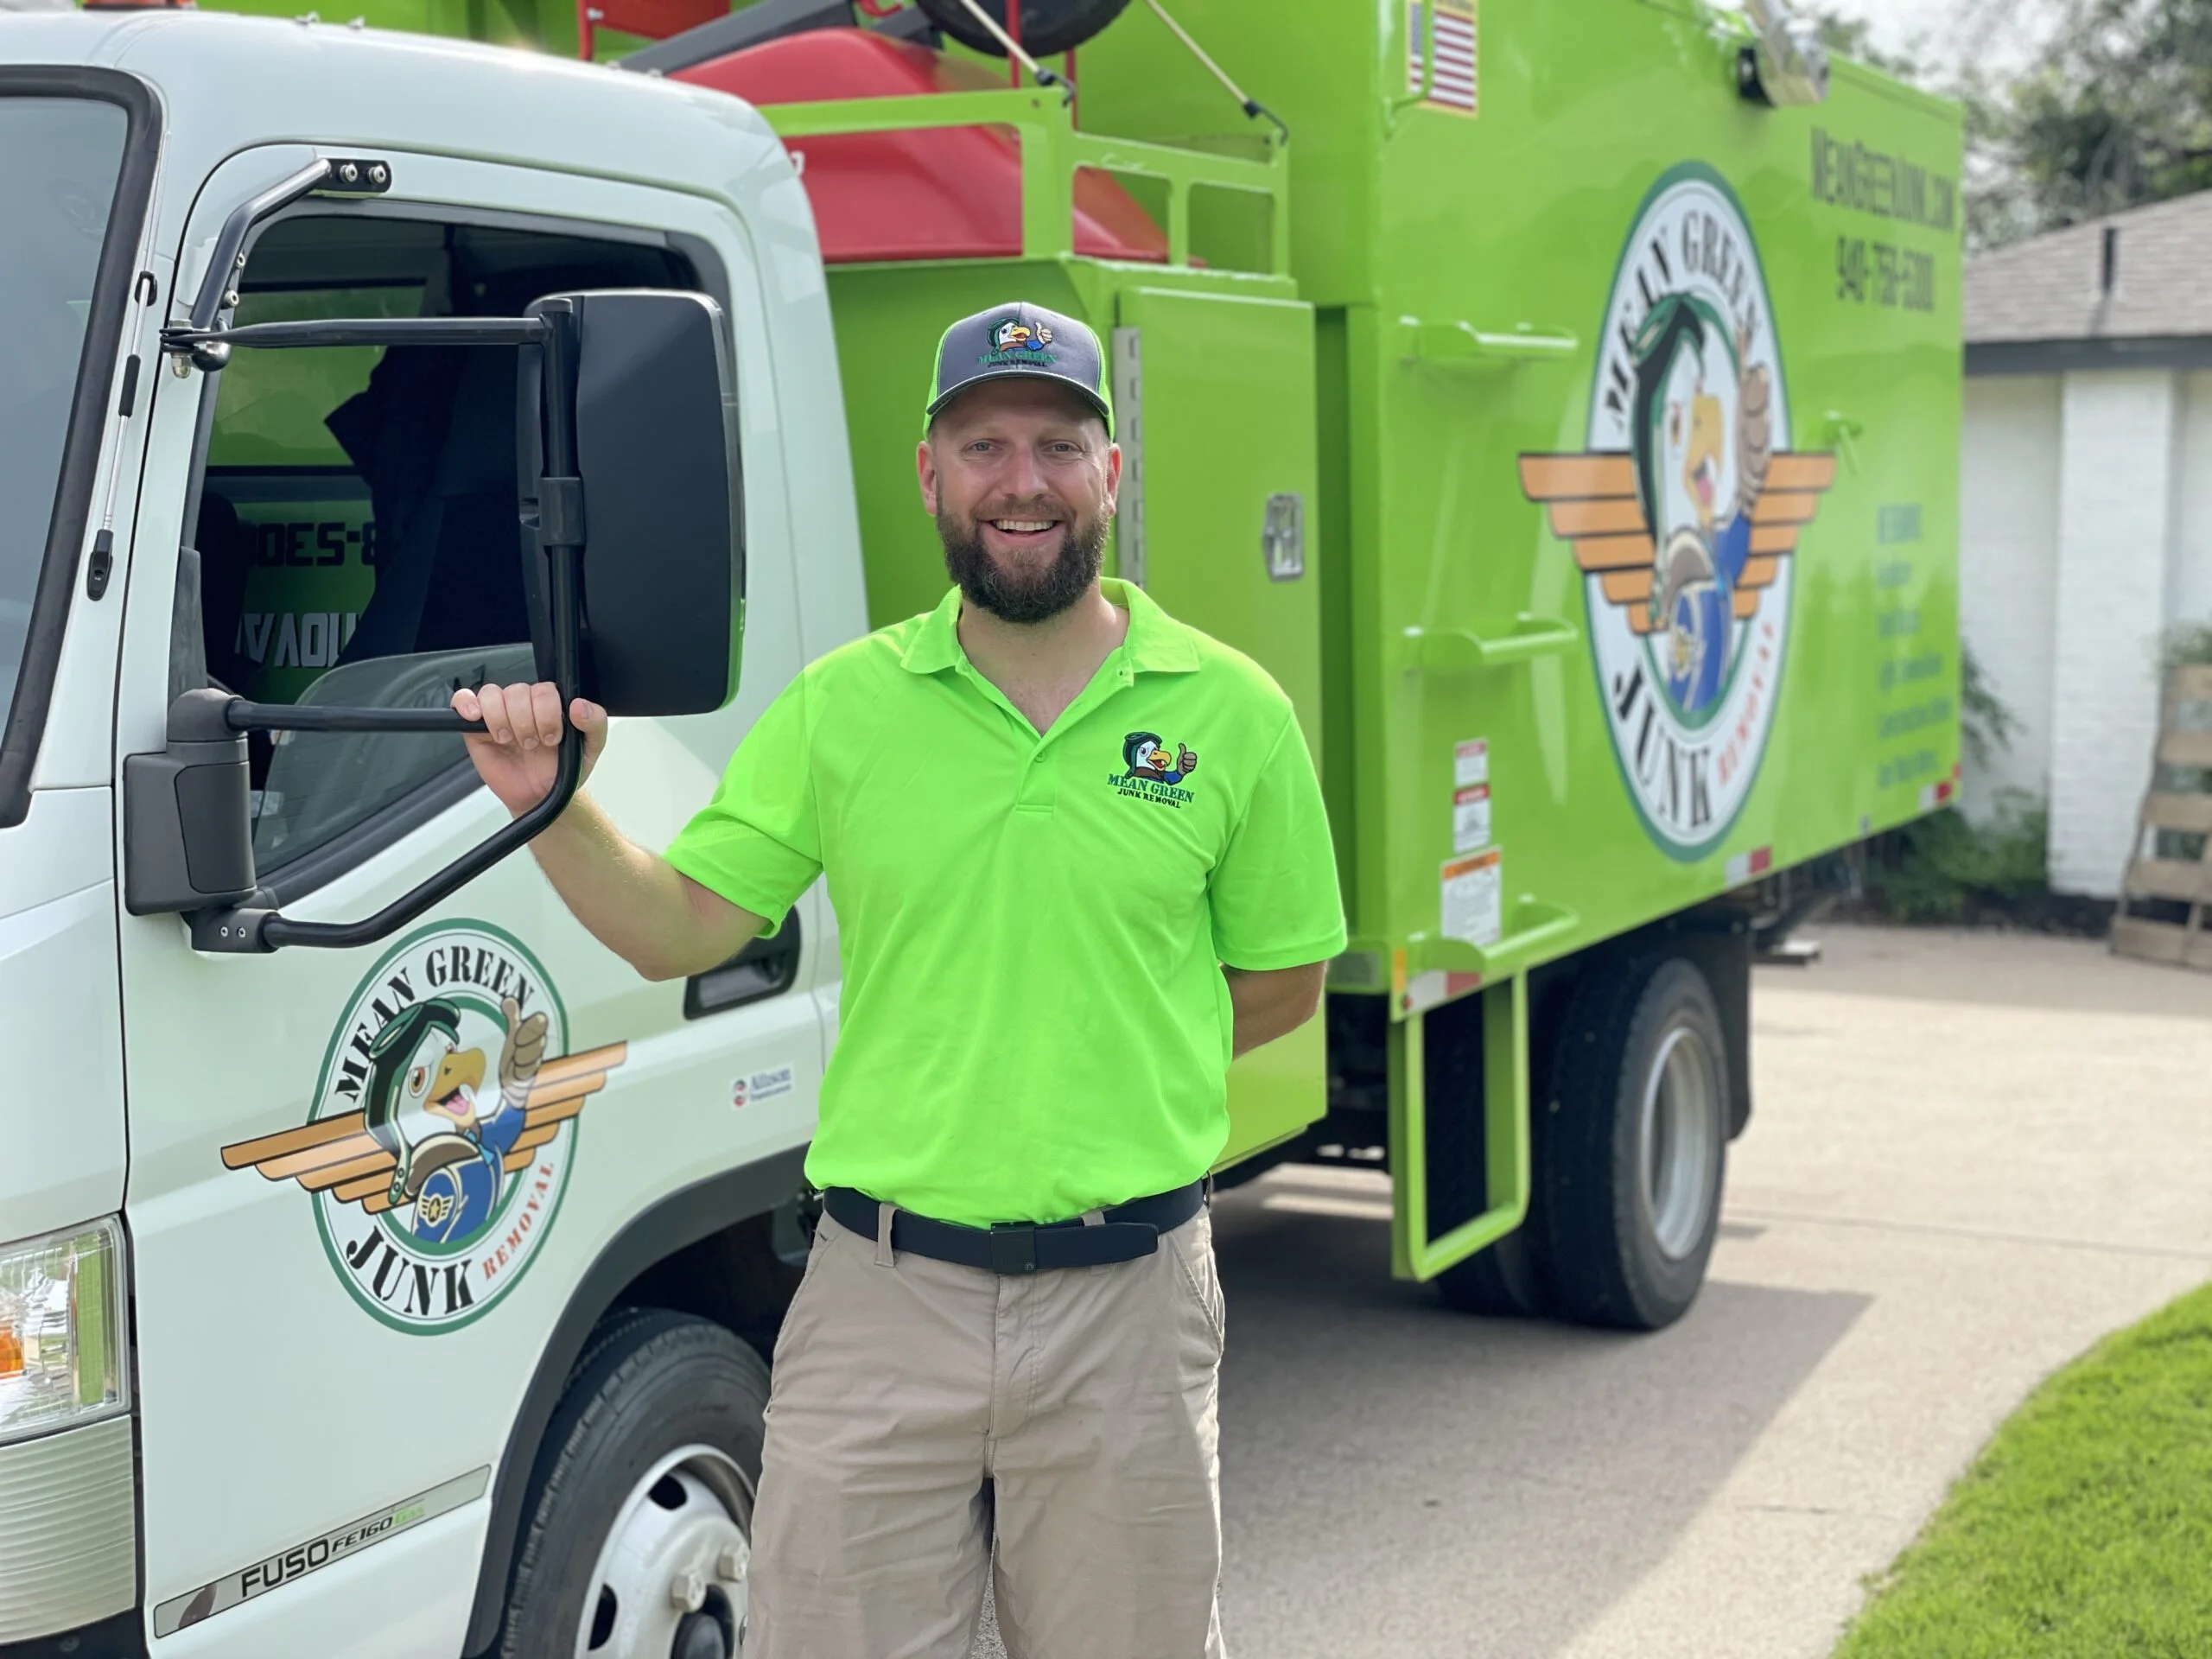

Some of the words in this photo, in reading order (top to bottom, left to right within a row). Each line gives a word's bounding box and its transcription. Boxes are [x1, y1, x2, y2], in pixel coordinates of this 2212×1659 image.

[978, 350, 1012, 364] MEAN
[1014, 350, 1057, 364] GREEN
[988, 359, 1009, 367] JUNK
[1009, 359, 1047, 367] REMOVAL
[1615, 660, 1712, 827] JUNK
[1107, 773, 1148, 791] MEAN
[1150, 783, 1195, 804] GREEN
[1117, 788, 1141, 799] JUNK
[1142, 793, 1181, 809] REMOVAL
[334, 967, 417, 1103] MEAN
[425, 945, 535, 1011] GREEN
[346, 1225, 474, 1316] JUNK
[481, 1162, 555, 1281] REMOVAL
[240, 1538, 329, 1598] FUSO
[331, 1516, 393, 1553] FE160
